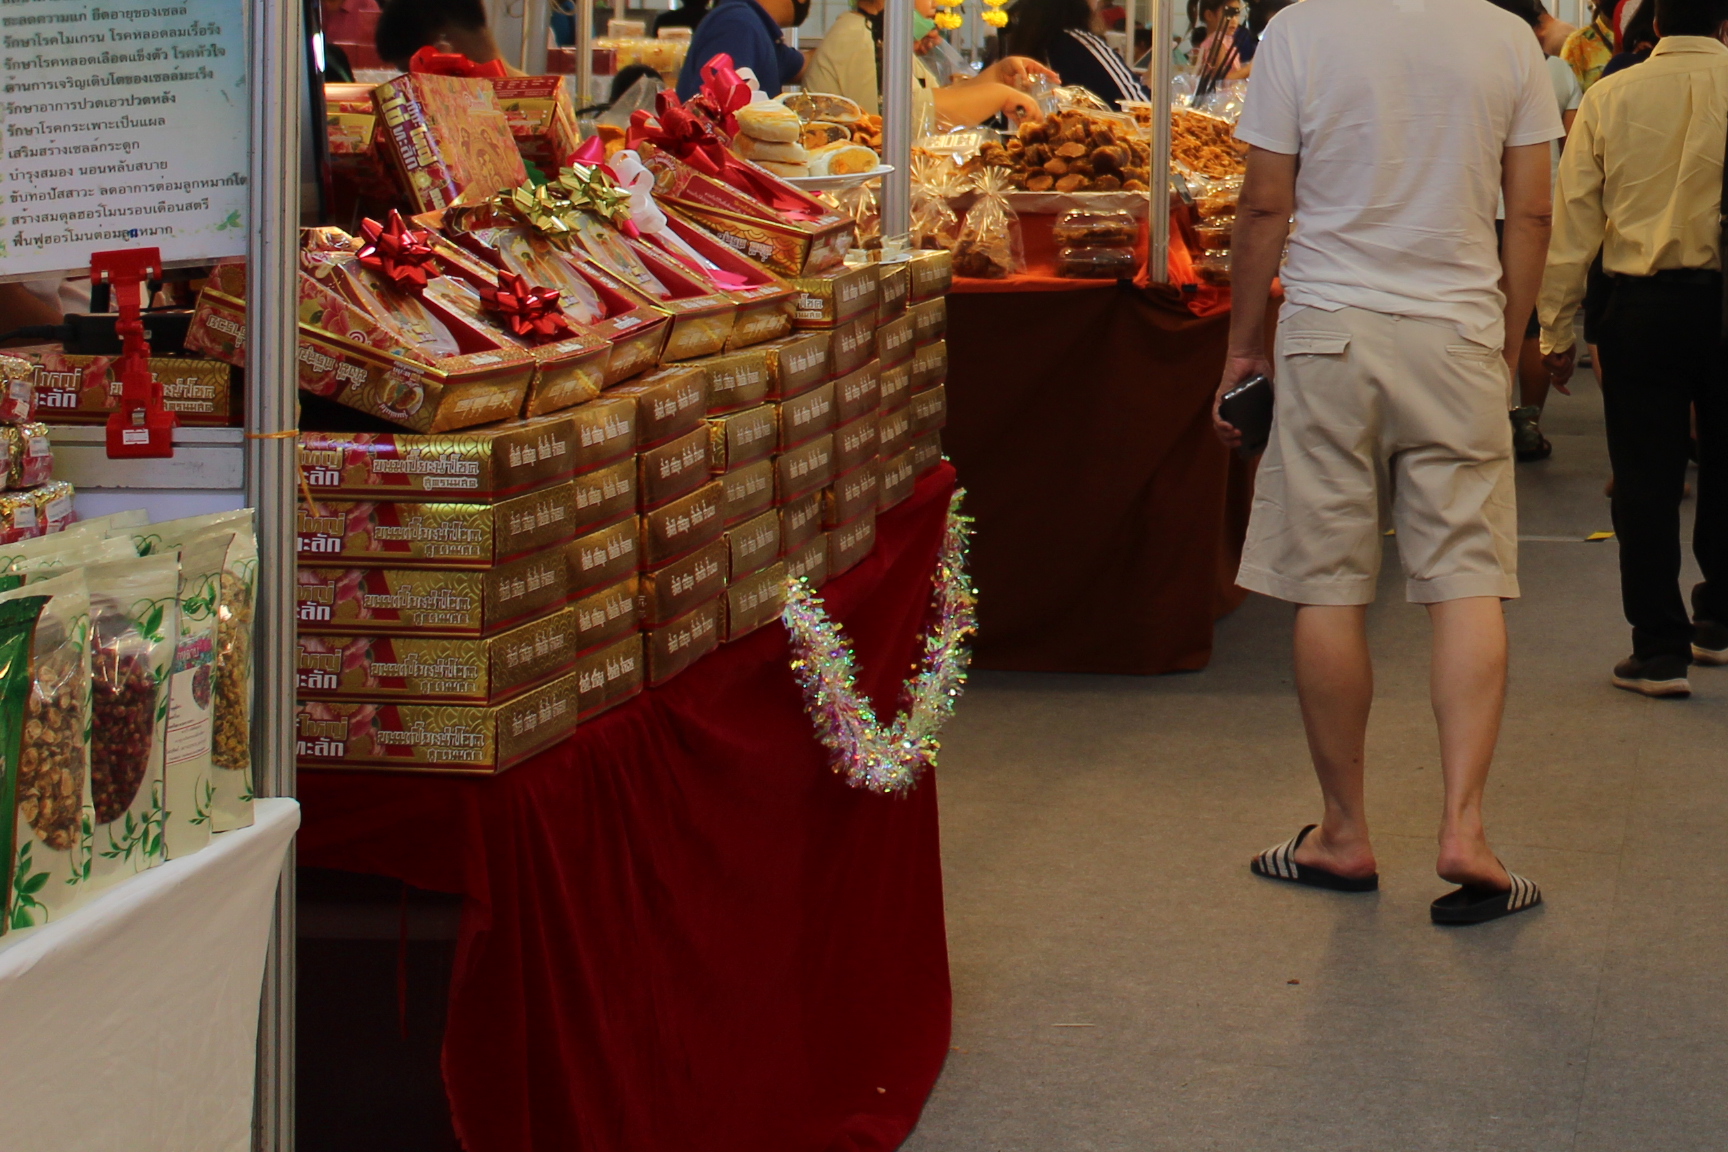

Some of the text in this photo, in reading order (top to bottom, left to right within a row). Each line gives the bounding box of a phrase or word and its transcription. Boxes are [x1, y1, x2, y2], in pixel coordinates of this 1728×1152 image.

[3, 21, 222, 50] รักษาโรคไมเกรน โรคหลอดลมเรื้อรัง
[4, 42, 227, 70] รักษาโรคหลอดเลือดแข็งตัว โรคหัวใจ
[6, 90, 177, 115] รักษาอาการปวดเอวปวดหลัง
[7, 115, 166, 138] รักษาโรคกระเพาะเป็นแผล
[8, 136, 140, 160] เสริมสร้างเซลล์กระดูก
[9, 159, 168, 185] บำรุงสมอง นอนหลับสบาย
[10, 184, 95, 204] ขับท่อปัสสาวะ
[11, 197, 210, 226] สร้างสมดุลฮอร์โมนรอบเดือนสตรี
[33, 389, 77, 409] ะลัก
